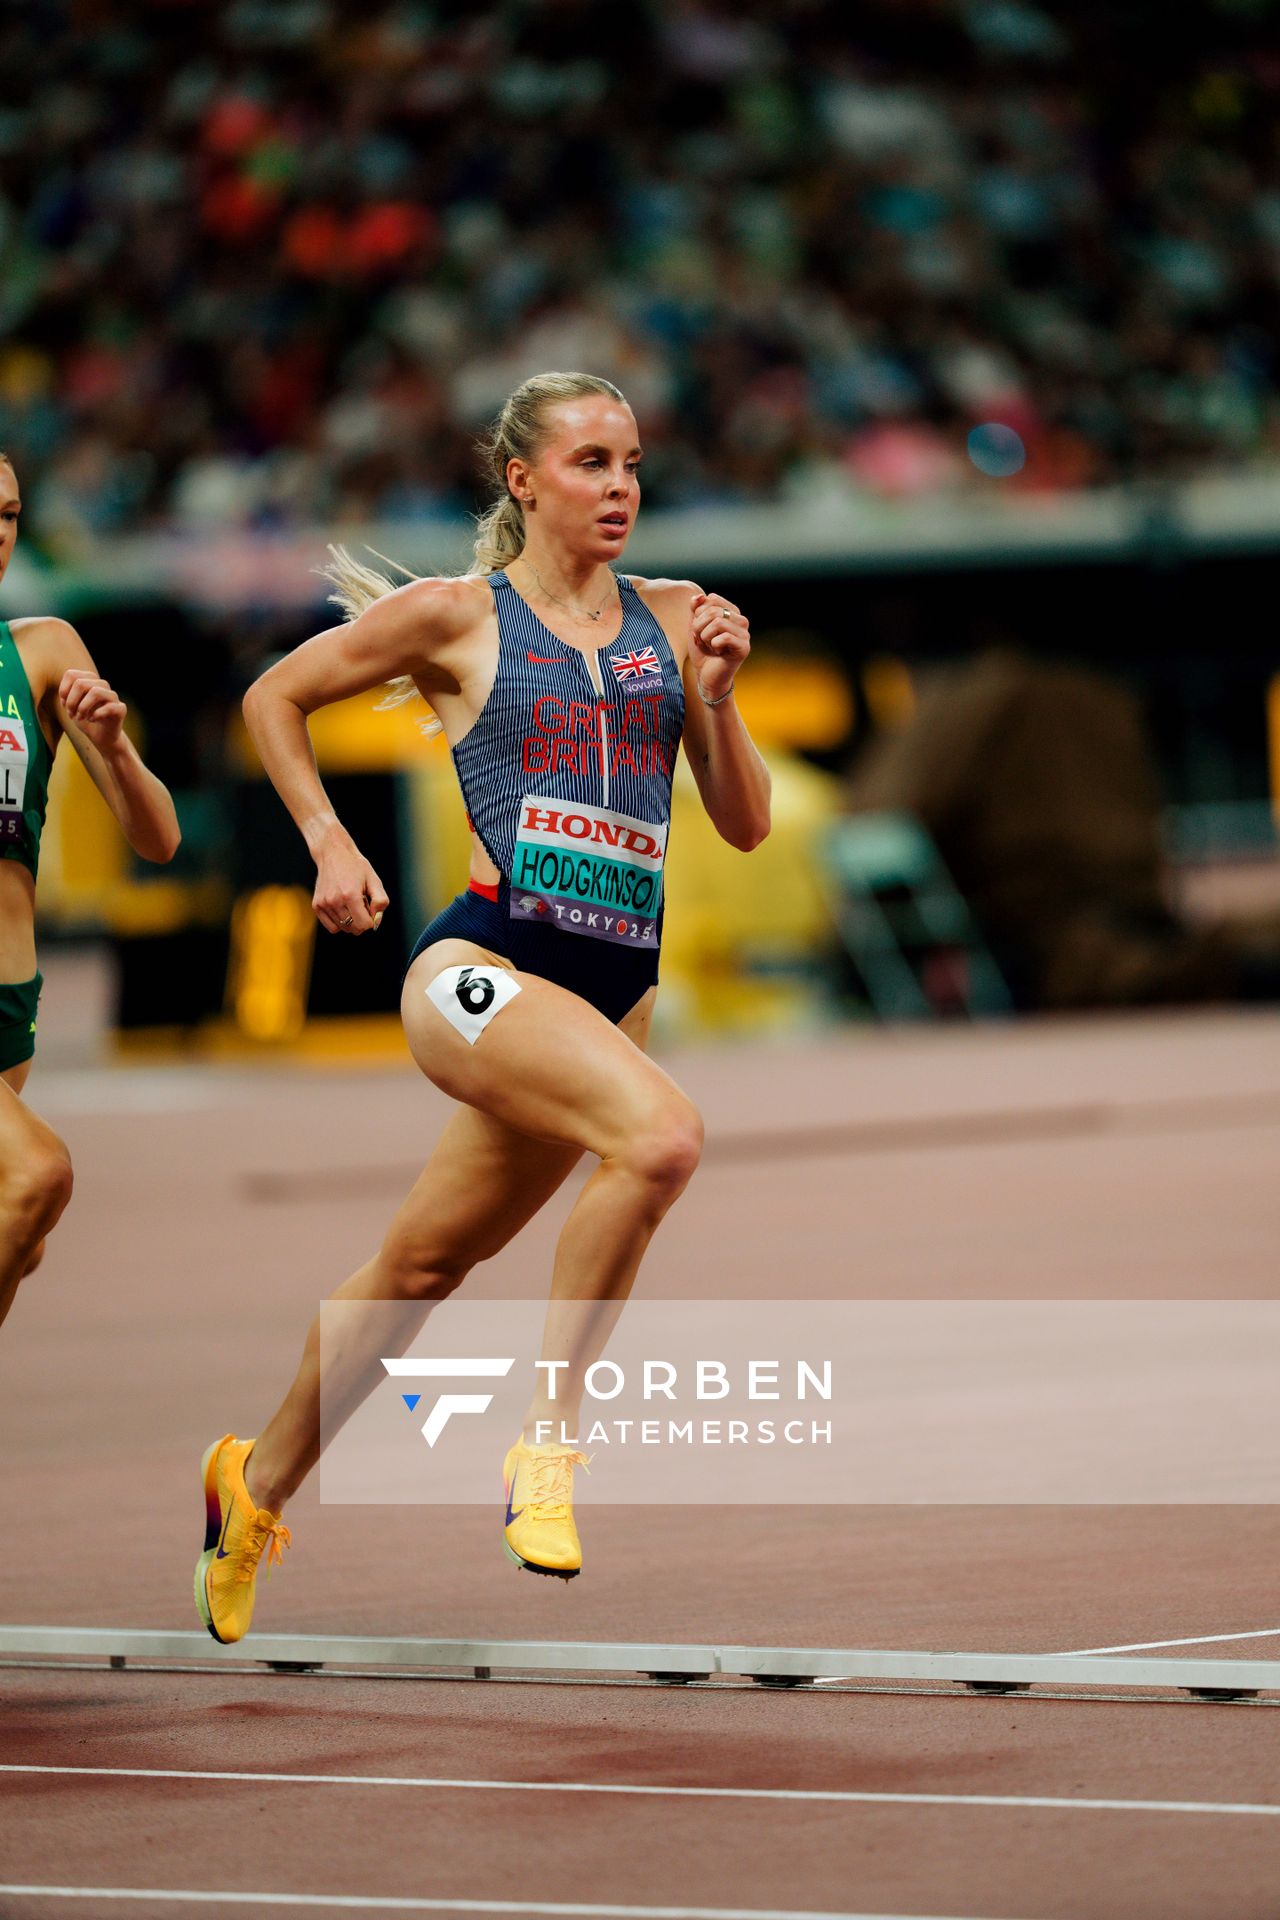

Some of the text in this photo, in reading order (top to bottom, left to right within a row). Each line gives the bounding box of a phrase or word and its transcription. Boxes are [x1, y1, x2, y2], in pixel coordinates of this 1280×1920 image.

[623, 678, 663, 693] Novuna
[533, 695, 665, 739] GREAT
[523, 737, 673, 778] BRITAIN
[455, 967, 495, 1015] 6
